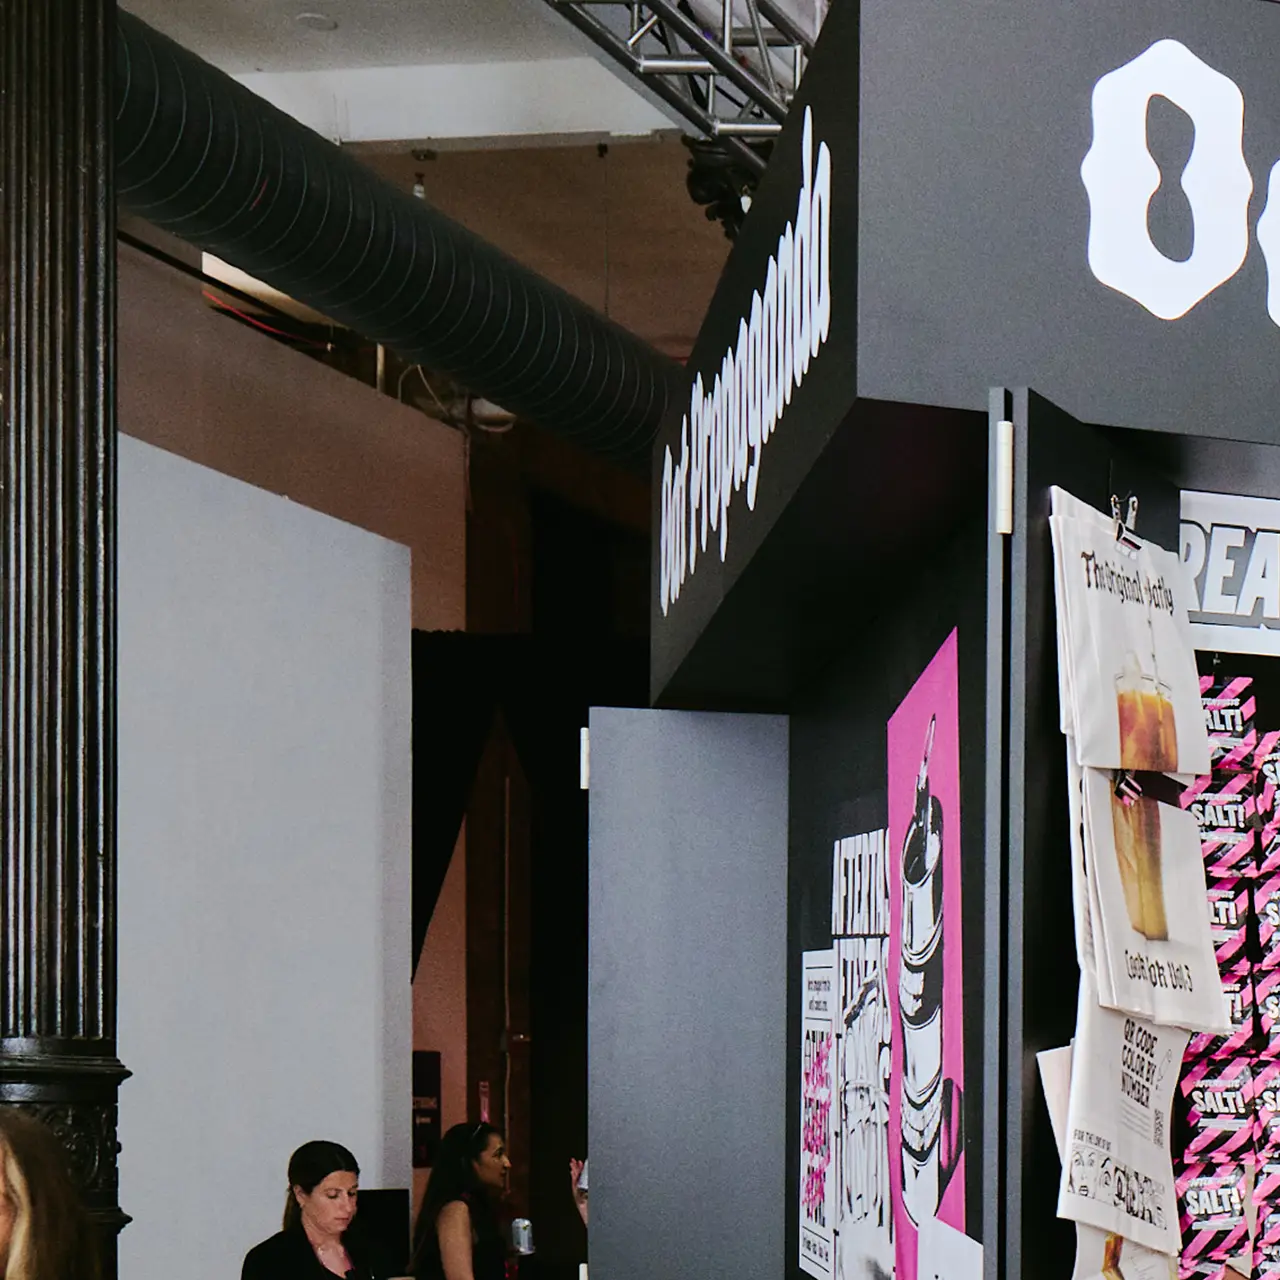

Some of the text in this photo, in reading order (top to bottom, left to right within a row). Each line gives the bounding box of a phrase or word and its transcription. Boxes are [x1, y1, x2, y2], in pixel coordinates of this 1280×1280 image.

[660, 105, 831, 616] Oat Propaganda
[1081, 551, 1105, 589] The
[1104, 561, 1144, 604] Original
[1191, 804, 1245, 828] SALT!
[1135, 1026, 1158, 1057] CODE
[1121, 1045, 1147, 1079] COLOR
[1120, 1070, 1151, 1108] NUMBER
[1191, 1090, 1246, 1114] SALT!
[1186, 1187, 1242, 1216] SALT!
